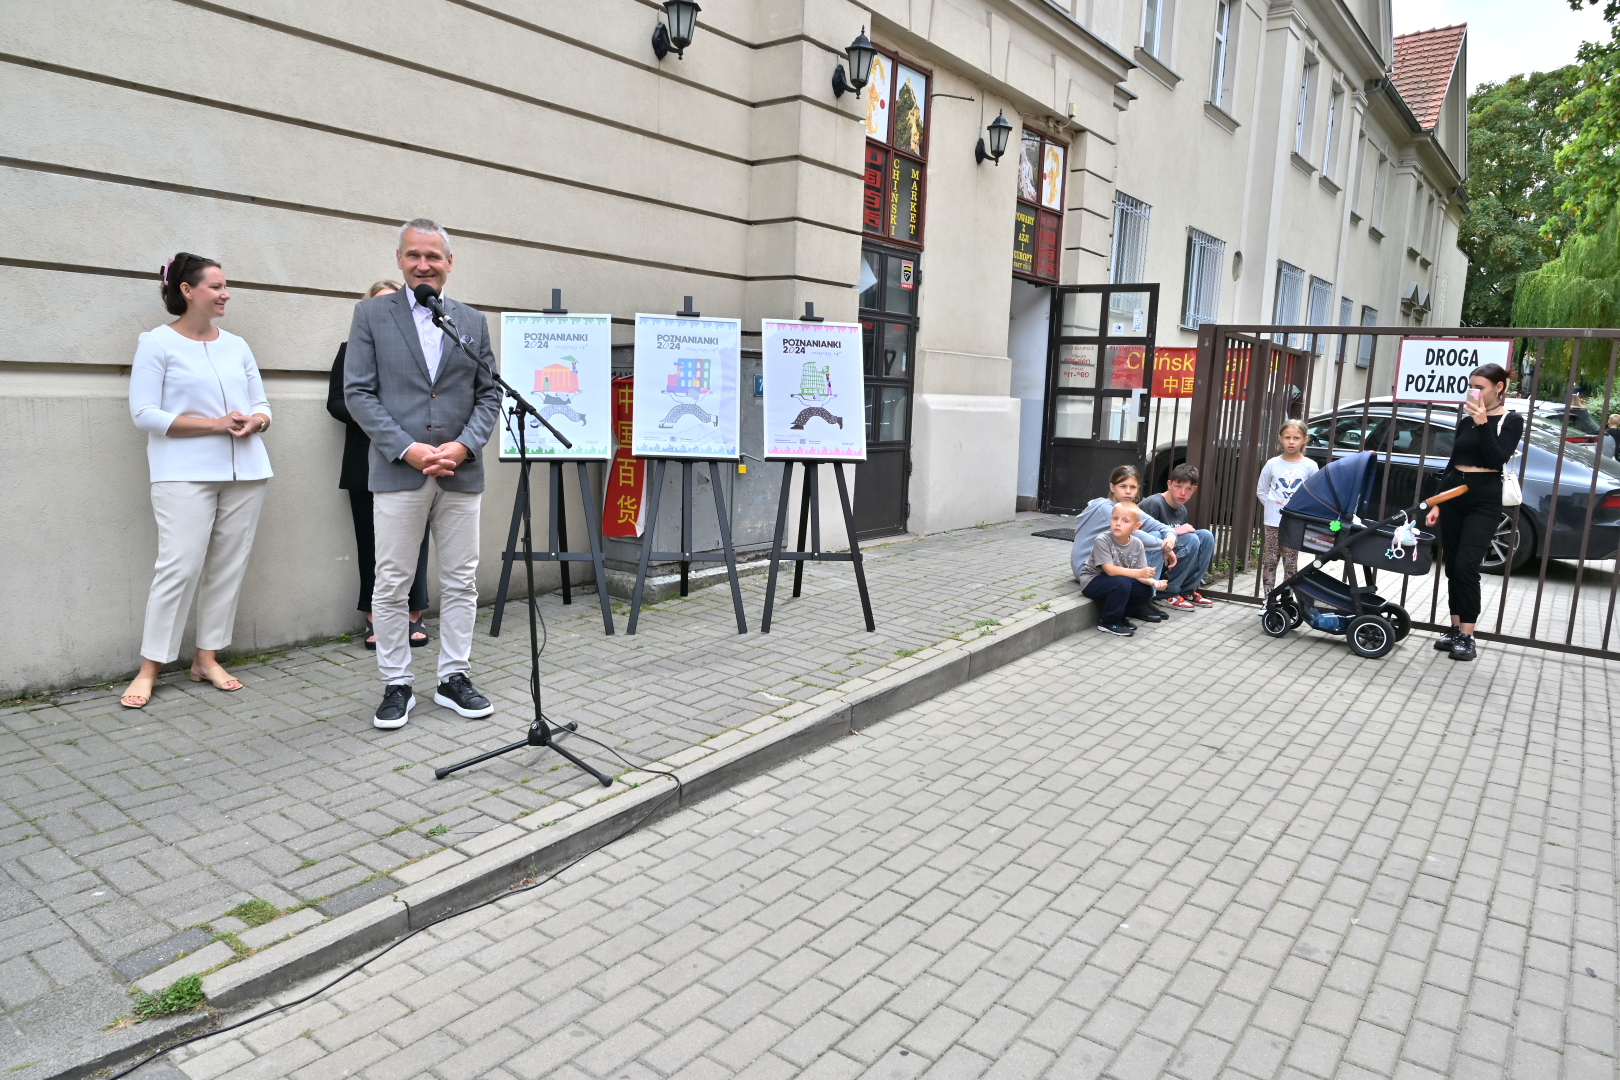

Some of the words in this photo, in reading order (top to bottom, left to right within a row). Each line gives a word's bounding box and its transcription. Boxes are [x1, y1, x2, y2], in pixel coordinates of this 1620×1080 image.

[890, 159, 900, 235] CHIŃSKI
[909, 168, 920, 234] MARKET
[524, 333, 588, 341] POZNANIANKI
[657, 334, 719, 345] POZNANIANKI
[524, 341, 549, 349] 2024
[657, 342, 680, 350] 2024
[782, 338, 842, 349] POZNANIANKI
[783, 346, 806, 354] 2024
[1425, 348, 1479, 366] DROGA
[1405, 369, 1469, 394] POŻARO
